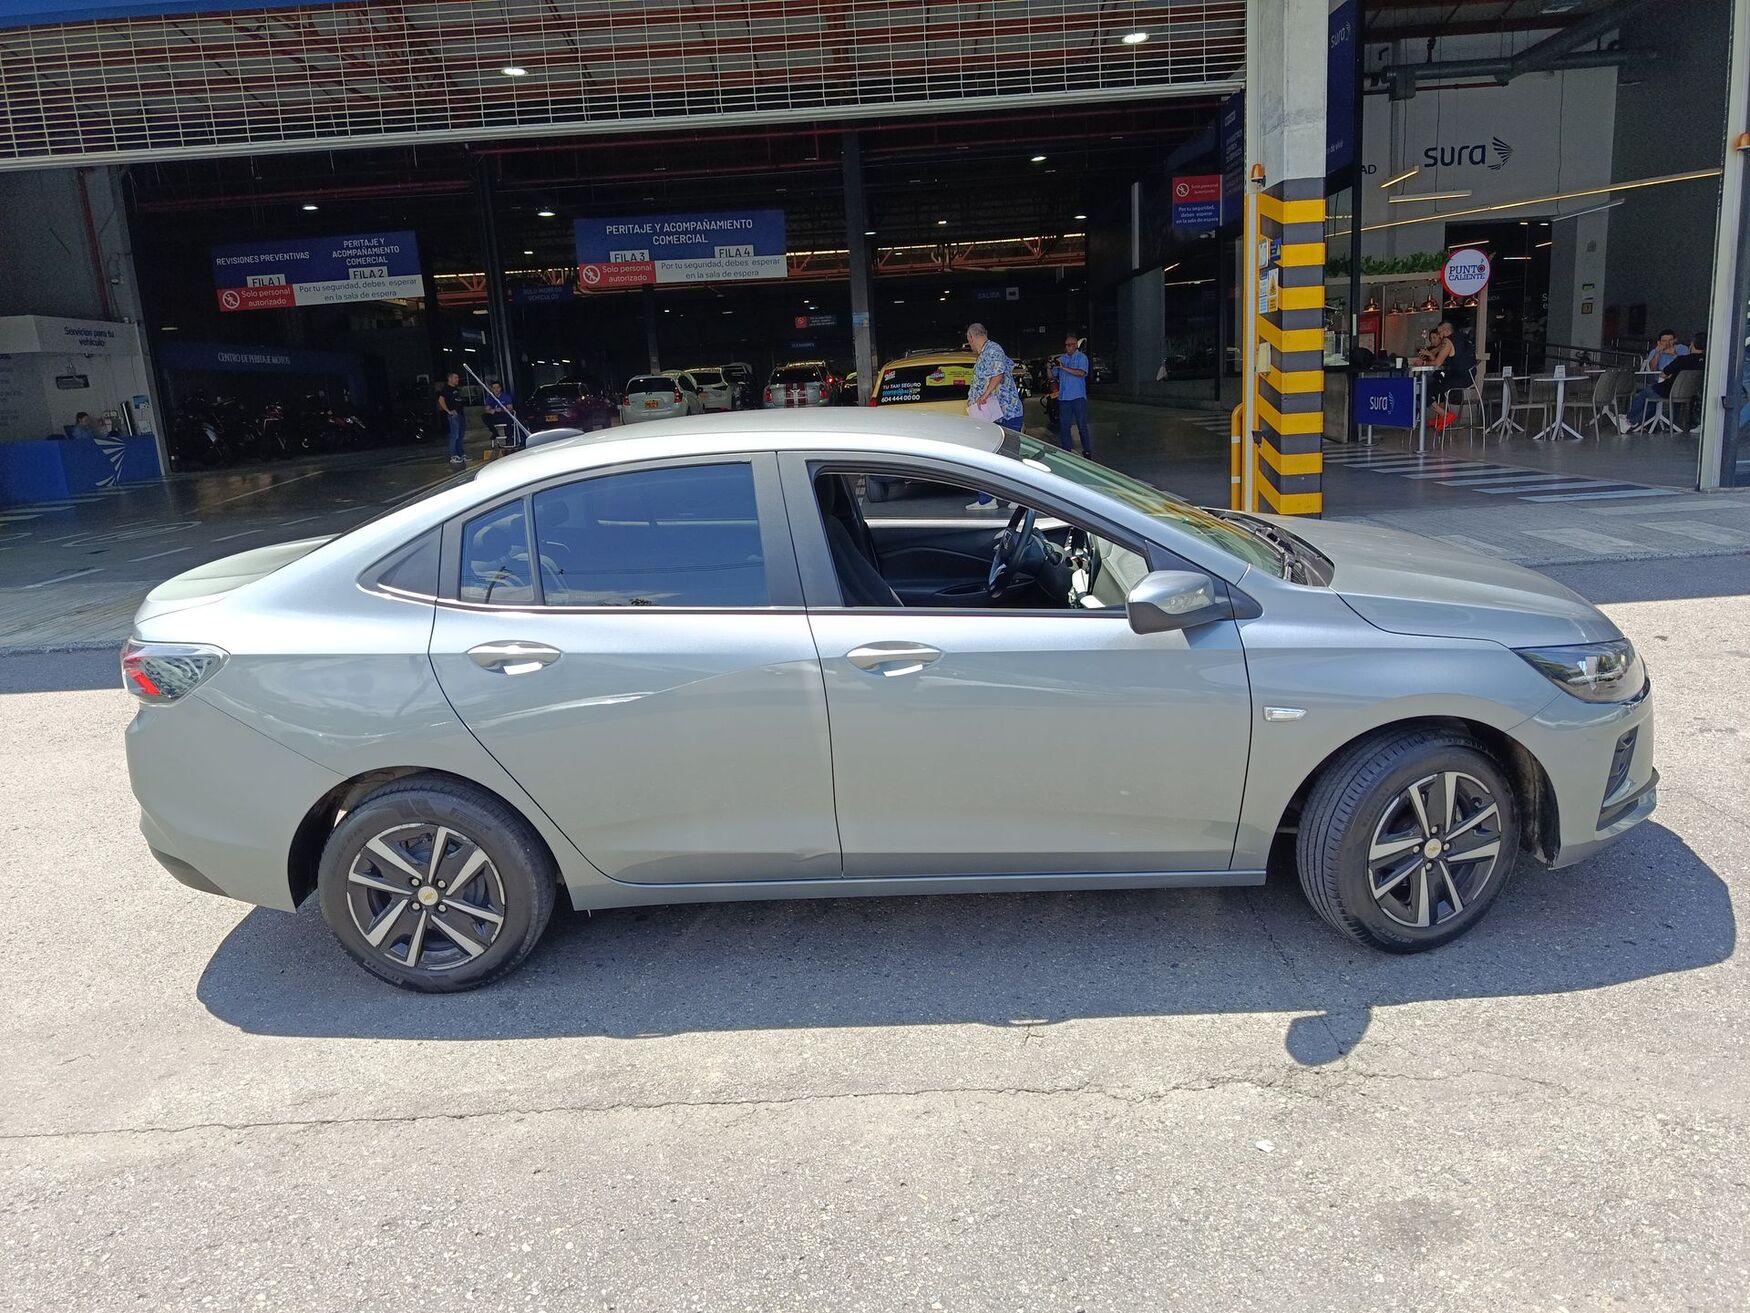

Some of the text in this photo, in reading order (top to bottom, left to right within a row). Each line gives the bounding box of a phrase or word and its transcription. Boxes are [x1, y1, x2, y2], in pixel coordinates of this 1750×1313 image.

[1424, 145, 1486, 167] sura
[606, 225, 652, 234] PERITAJE
[664, 219, 753, 232] ACOMPAÑAMIENTO
[343, 239, 379, 248] PERITAJE
[653, 234, 708, 245] COMERCIAL
[333, 245, 400, 258] ACOMPAÑAMIENTO
[719, 247, 750, 258] FILA 4
[216, 252, 310, 266] REVISIONES PREVENTIVAS
[346, 256, 388, 266] COMERCIAL
[614, 252, 646, 263] FILA 3
[684, 260, 724, 269] seguridad,
[726, 258, 749, 266] debes
[752, 257, 780, 266] esperar
[353, 269, 384, 280] FILA 2
[620, 264, 652, 274] personal
[733, 269, 759, 278] espera
[1449, 264, 1486, 275] PUNTO
[252, 276, 281, 286] FILA 1
[609, 273, 647, 282] autorizado
[1448, 273, 1486, 282] CALIENTE
[322, 282, 360, 293] seguridad,
[362, 280, 386, 288] debes
[388, 279, 417, 287] esperar
[259, 288, 291, 298] personal
[372, 291, 397, 300] espera
[249, 298, 287, 307] autorizado
[64, 327, 93, 337] Servicios
[1369, 395, 1388, 411] sura
